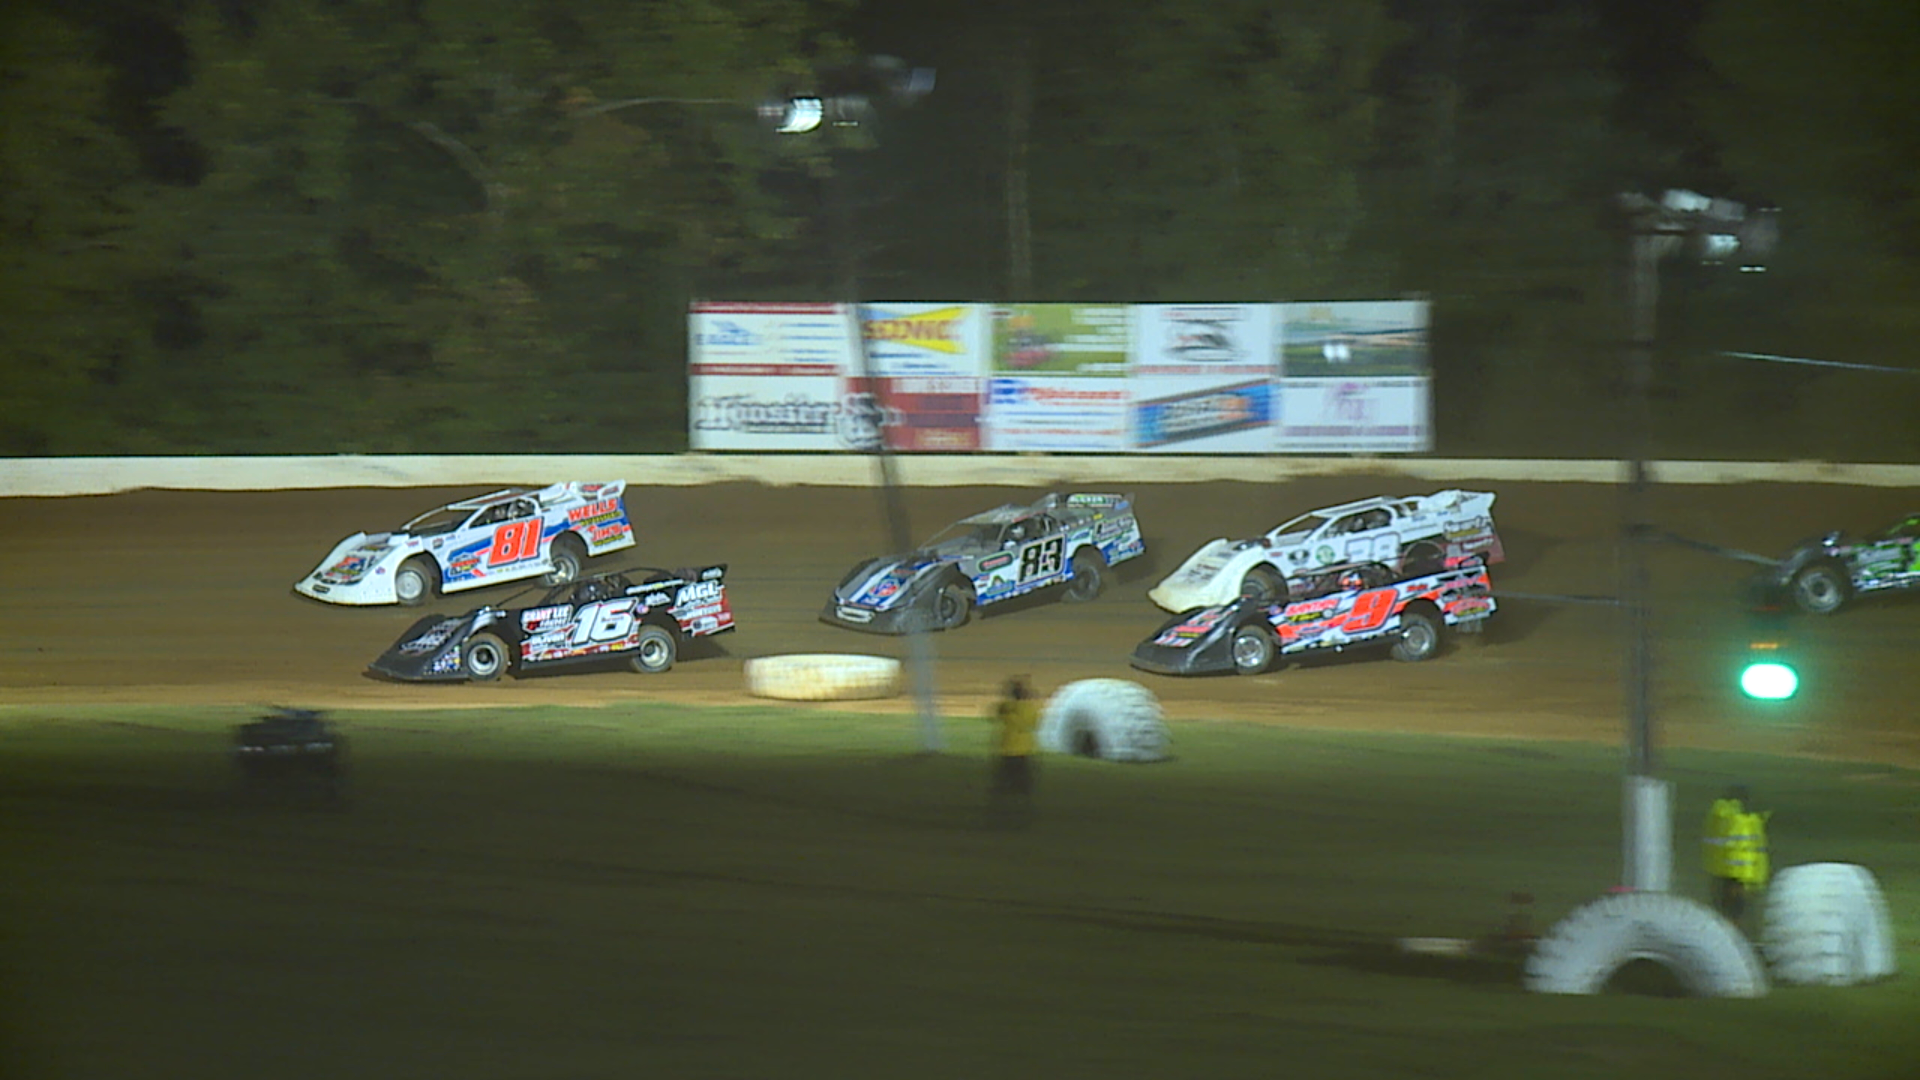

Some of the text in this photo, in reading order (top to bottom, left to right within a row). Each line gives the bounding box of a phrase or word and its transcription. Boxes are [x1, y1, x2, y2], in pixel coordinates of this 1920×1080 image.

[568, 498, 618, 523] WELLS
[487, 516, 544, 568] 81
[571, 597, 639, 646] 16
[1341, 588, 1398, 634] 9
